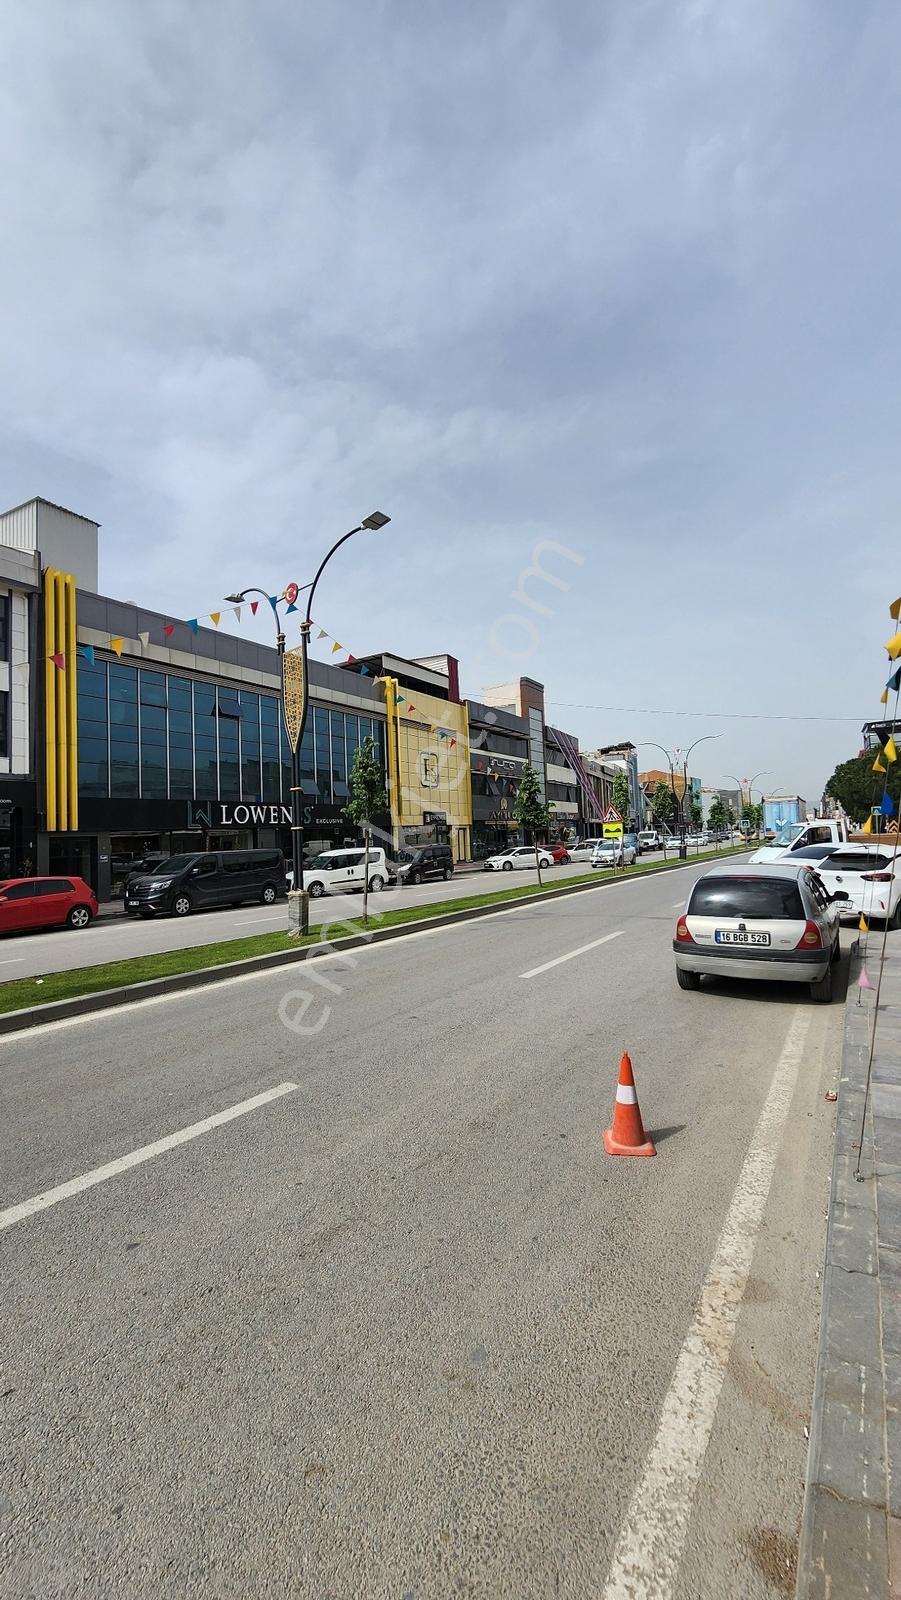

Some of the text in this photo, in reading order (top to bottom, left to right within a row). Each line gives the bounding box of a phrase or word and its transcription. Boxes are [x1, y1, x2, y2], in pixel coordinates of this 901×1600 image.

[722, 933, 731, 941] 16
[733, 933, 749, 942] BGB
[751, 934, 768, 943] 528
